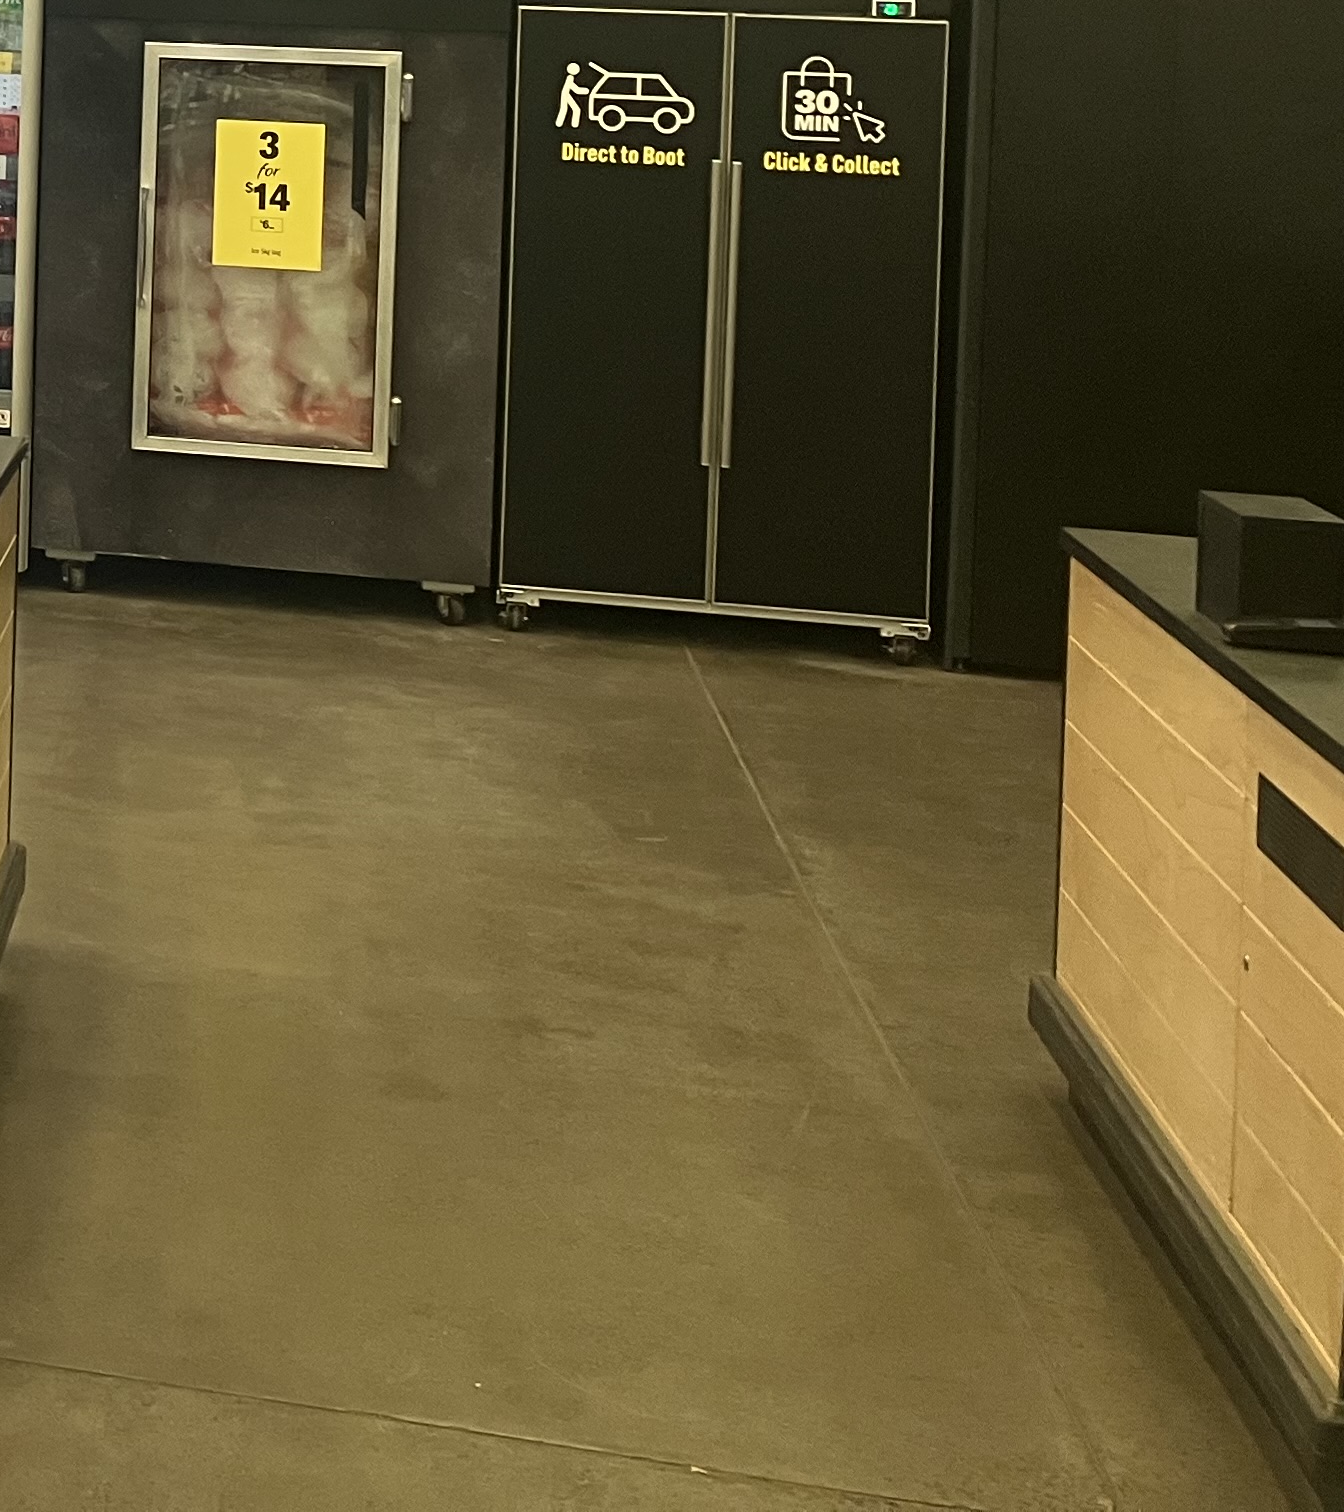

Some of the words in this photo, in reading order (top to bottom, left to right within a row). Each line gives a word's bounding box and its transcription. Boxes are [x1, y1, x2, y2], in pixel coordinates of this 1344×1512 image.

[794, 90, 840, 115] 30
[794, 115, 840, 133] MIN
[259, 131, 280, 160] 3
[562, 142, 616, 164] Direct
[621, 145, 639, 164] to
[643, 146, 685, 167] Boot
[257, 163, 281, 179] for
[763, 151, 810, 172] Click
[814, 153, 829, 172] &
[832, 154, 900, 176] Collect
[245, 181, 290, 212] $14
